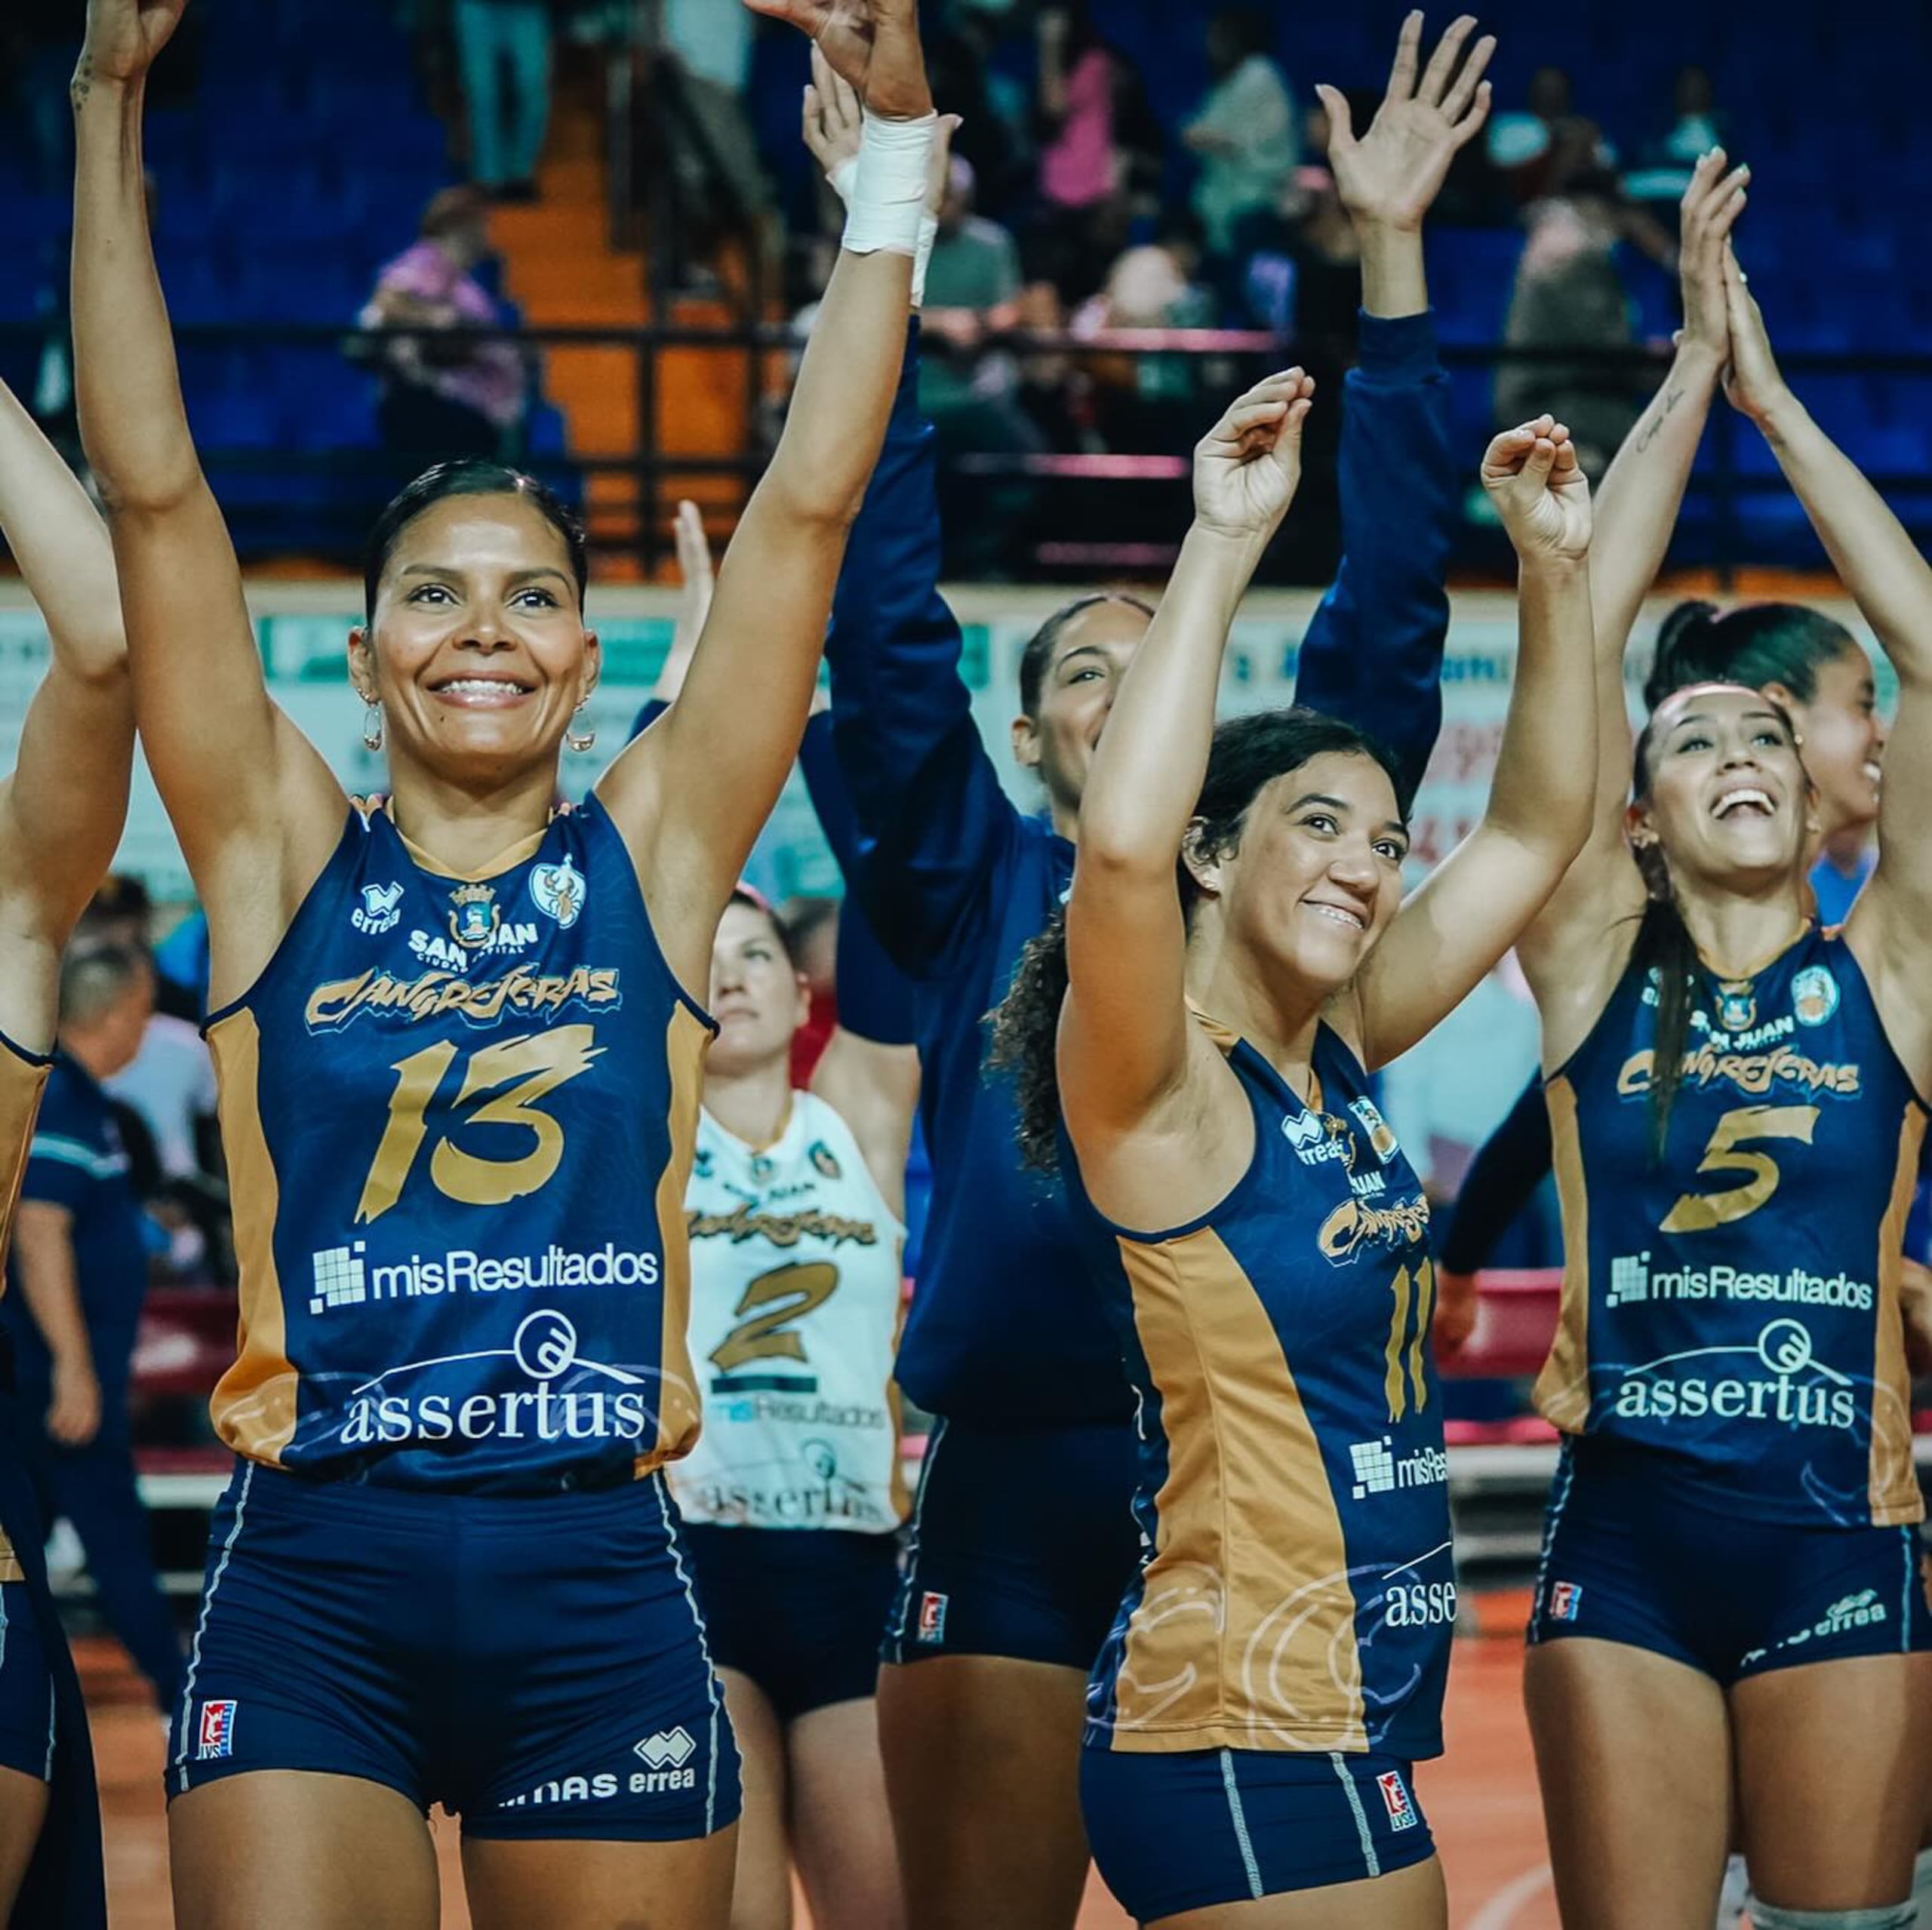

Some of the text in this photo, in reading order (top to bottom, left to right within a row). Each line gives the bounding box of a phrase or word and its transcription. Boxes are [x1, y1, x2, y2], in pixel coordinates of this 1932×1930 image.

[408, 923, 538, 967] SAN JAN
[472, 945, 525, 963] PITAL
[1733, 1016, 1795, 1051] JUAN
[1617, 1043, 1861, 1098] CNGREJERAS
[354, 1024, 608, 1224] 13
[1295, 1140, 1340, 1166] rrea
[1660, 1105, 1821, 1233] 5
[372, 1243, 658, 1299] misResultados
[1652, 1265, 1872, 1311] misResultados
[709, 1261, 839, 1376] 2
[1384, 1255, 1433, 1424] 11
[340, 1381, 645, 1444] assertus
[1616, 1374, 1856, 1429] assertus
